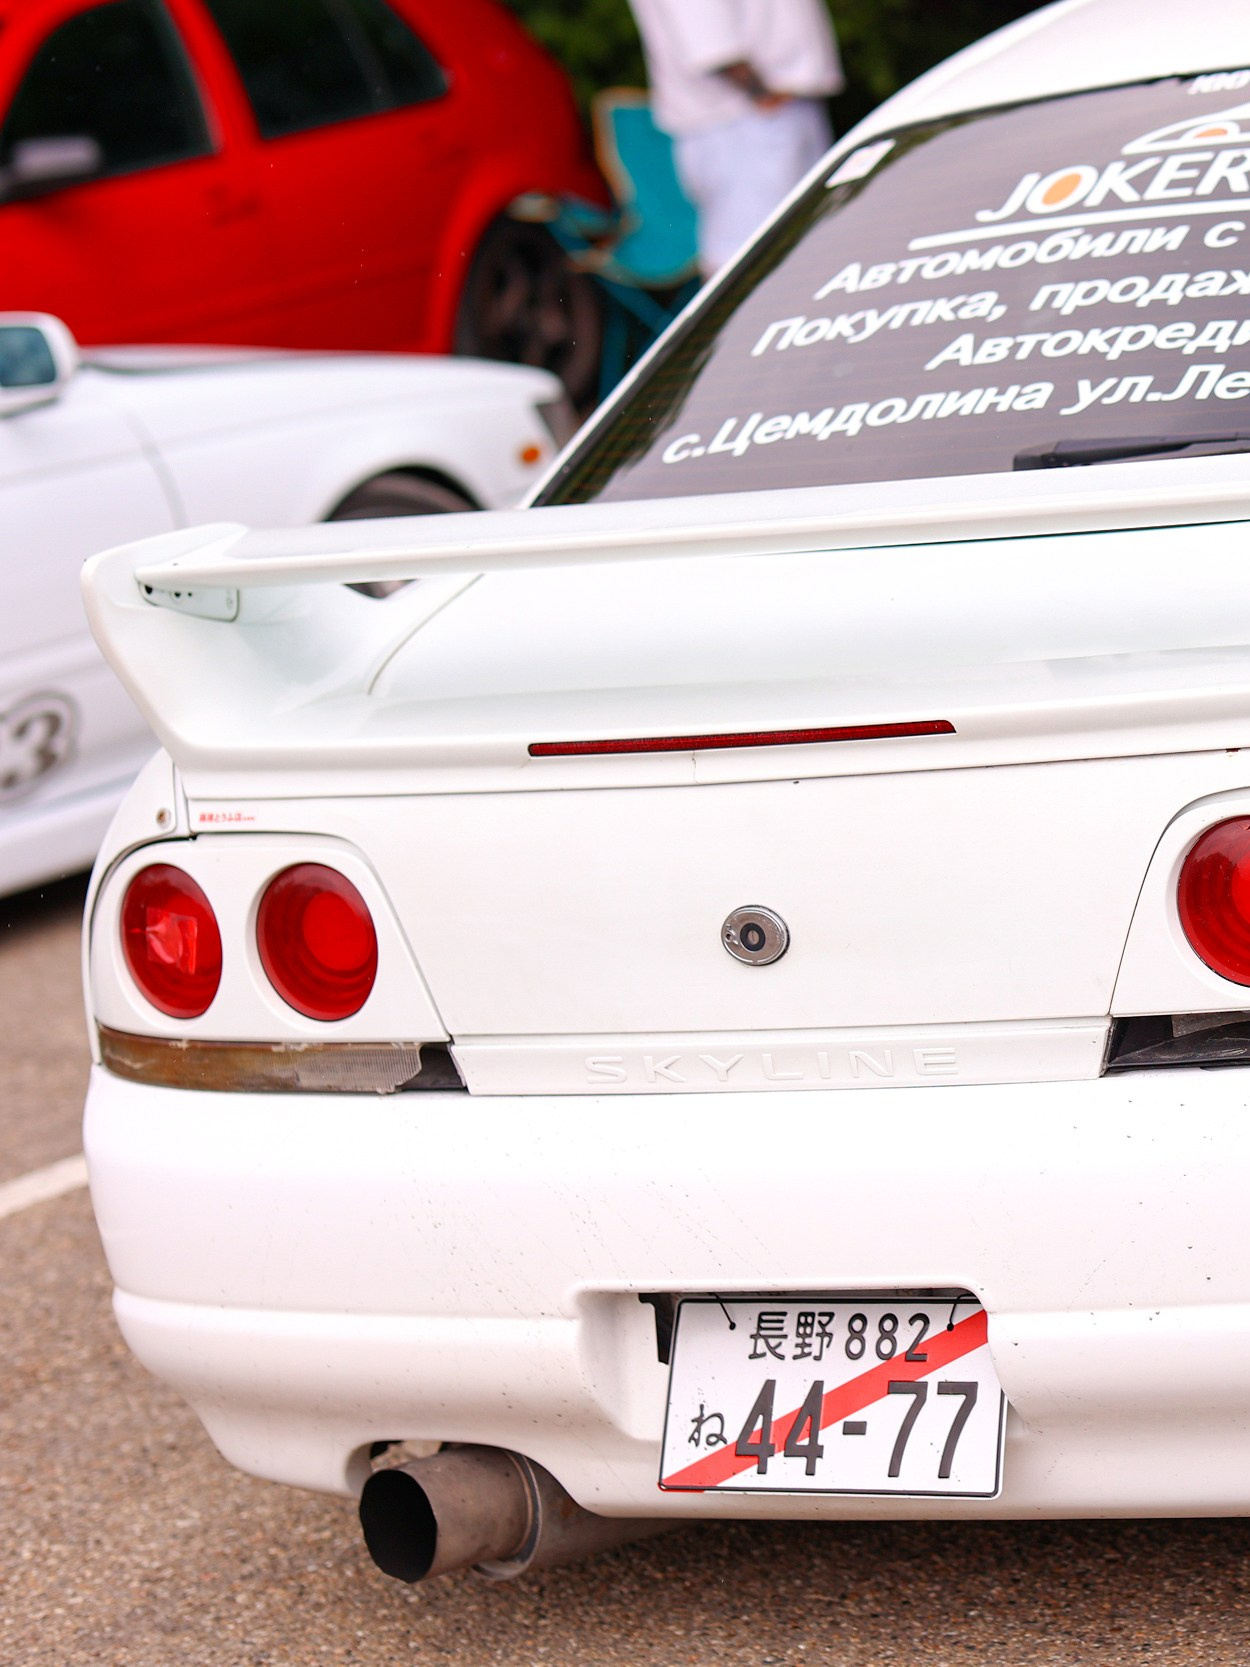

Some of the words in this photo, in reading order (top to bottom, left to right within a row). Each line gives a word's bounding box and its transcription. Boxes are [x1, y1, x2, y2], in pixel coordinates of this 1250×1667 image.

[812, 224, 1191, 301] Автомобили
[1202, 220, 1246, 249] с
[750, 290, 1008, 358] Покупка,
[661, 381, 1055, 465] с.Цемдолина
[584, 1047, 960, 1085] SKYLINE
[748, 1310, 836, 1362] 長野
[844, 1312, 931, 1362] 882
[688, 1403, 729, 1448] ね
[735, 1379, 979, 1479] 44-77
